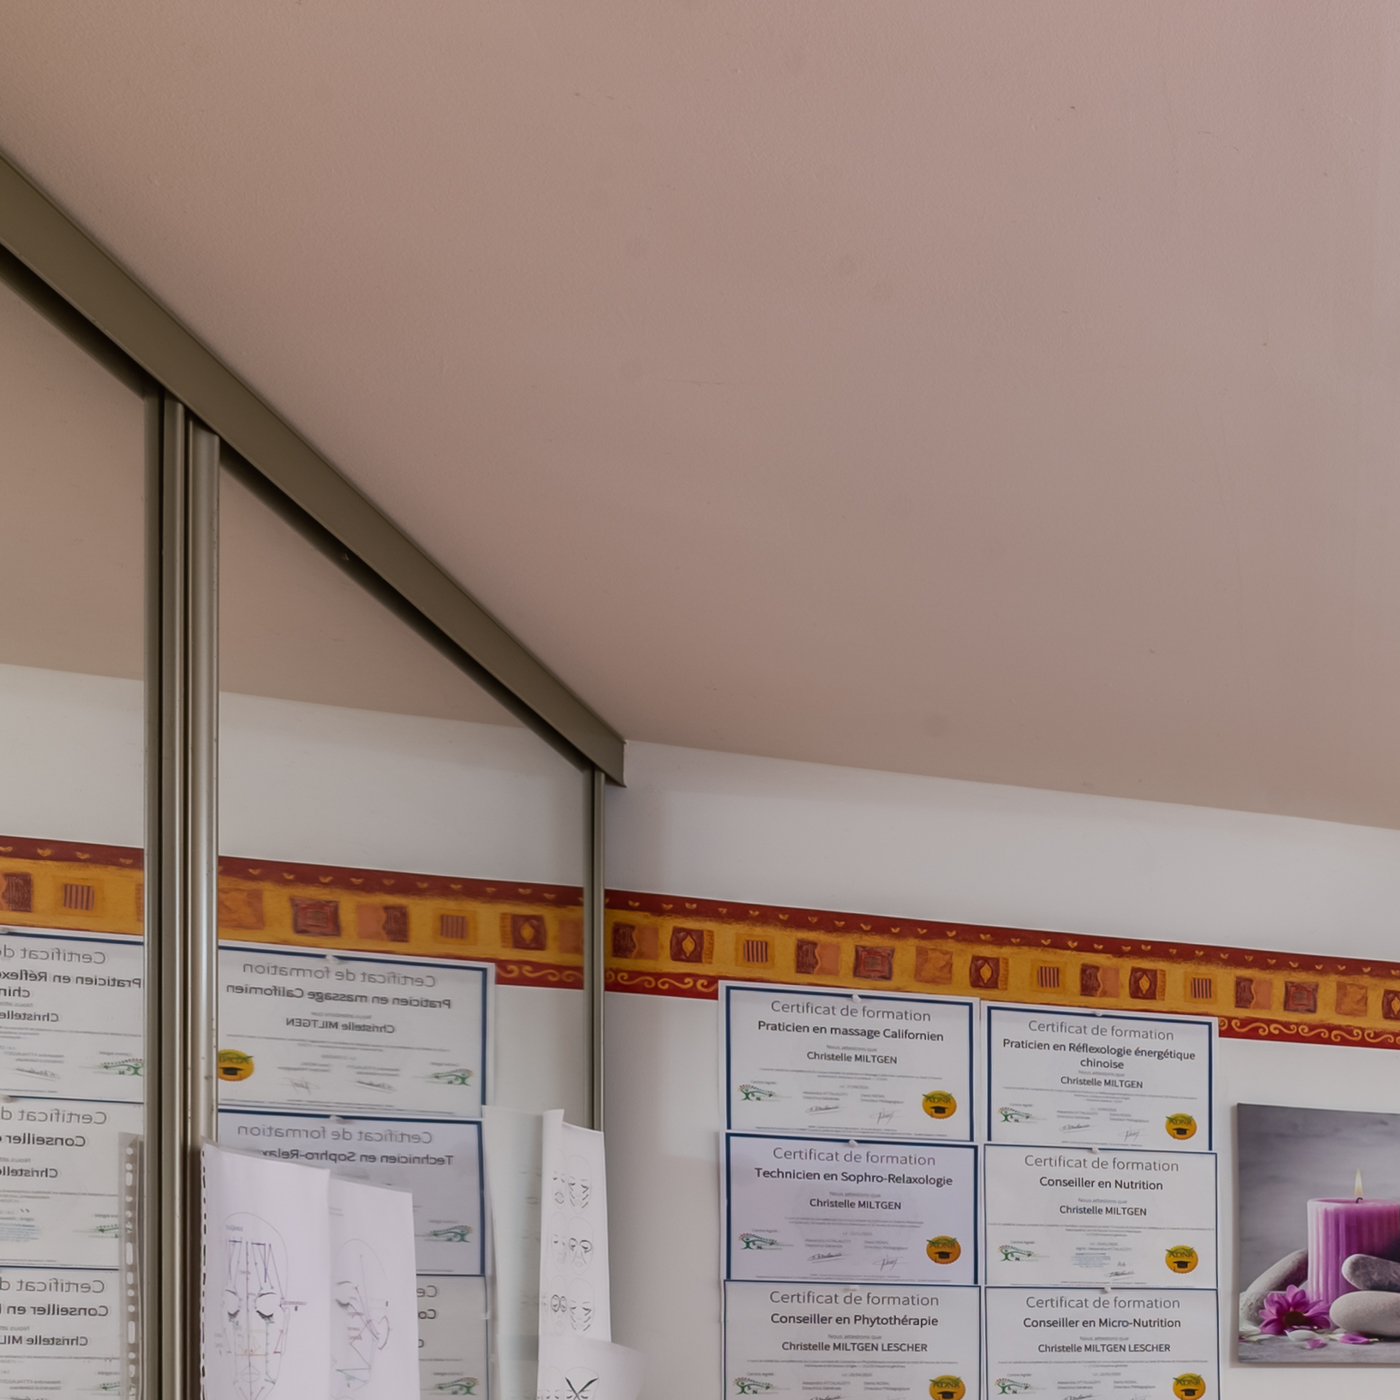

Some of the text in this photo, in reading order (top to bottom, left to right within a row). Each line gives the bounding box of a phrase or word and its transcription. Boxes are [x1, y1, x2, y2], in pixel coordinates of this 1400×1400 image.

[771, 1001, 931, 1021] Certificat de formation
[758, 1021, 943, 1041] Praticien en massage Californien
[1029, 1020, 1174, 1040] Certificat de formation
[1003, 1039, 1050, 1050] Praticien
[1069, 1043, 1132, 1056] Réflexologie
[1135, 1048, 1195, 1060] énergétique
[807, 1051, 897, 1064] Christelle MILTGEN
[1080, 1058, 1124, 1069] chinoise
[1061, 1076, 1143, 1088] Christelle MILTGEN
[773, 1147, 935, 1165] Certificat de formation
[1025, 1155, 1179, 1172] Certificat de formation
[755, 1168, 953, 1187] Technicien en Sophro-Relaxologie
[1040, 1177, 1163, 1190] Conseiller en Nutrition
[810, 1199, 901, 1210] Christelle MILTGEN
[1060, 1206, 1146, 1216] Christelle MILTGEN
[770, 1291, 939, 1306] Certificat de formation
[1026, 1296, 1180, 1308] Certificat de formation
[771, 1313, 938, 1327] Conseiller en Phytothérapie
[1023, 1317, 1181, 1328] Conseiller en Micro-Nutrition
[782, 1342, 927, 1352] Christelle MILTGEN LESCHER
[1038, 1344, 1082, 1353] Christelle
[1129, 1344, 1170, 1352] LESCHER
